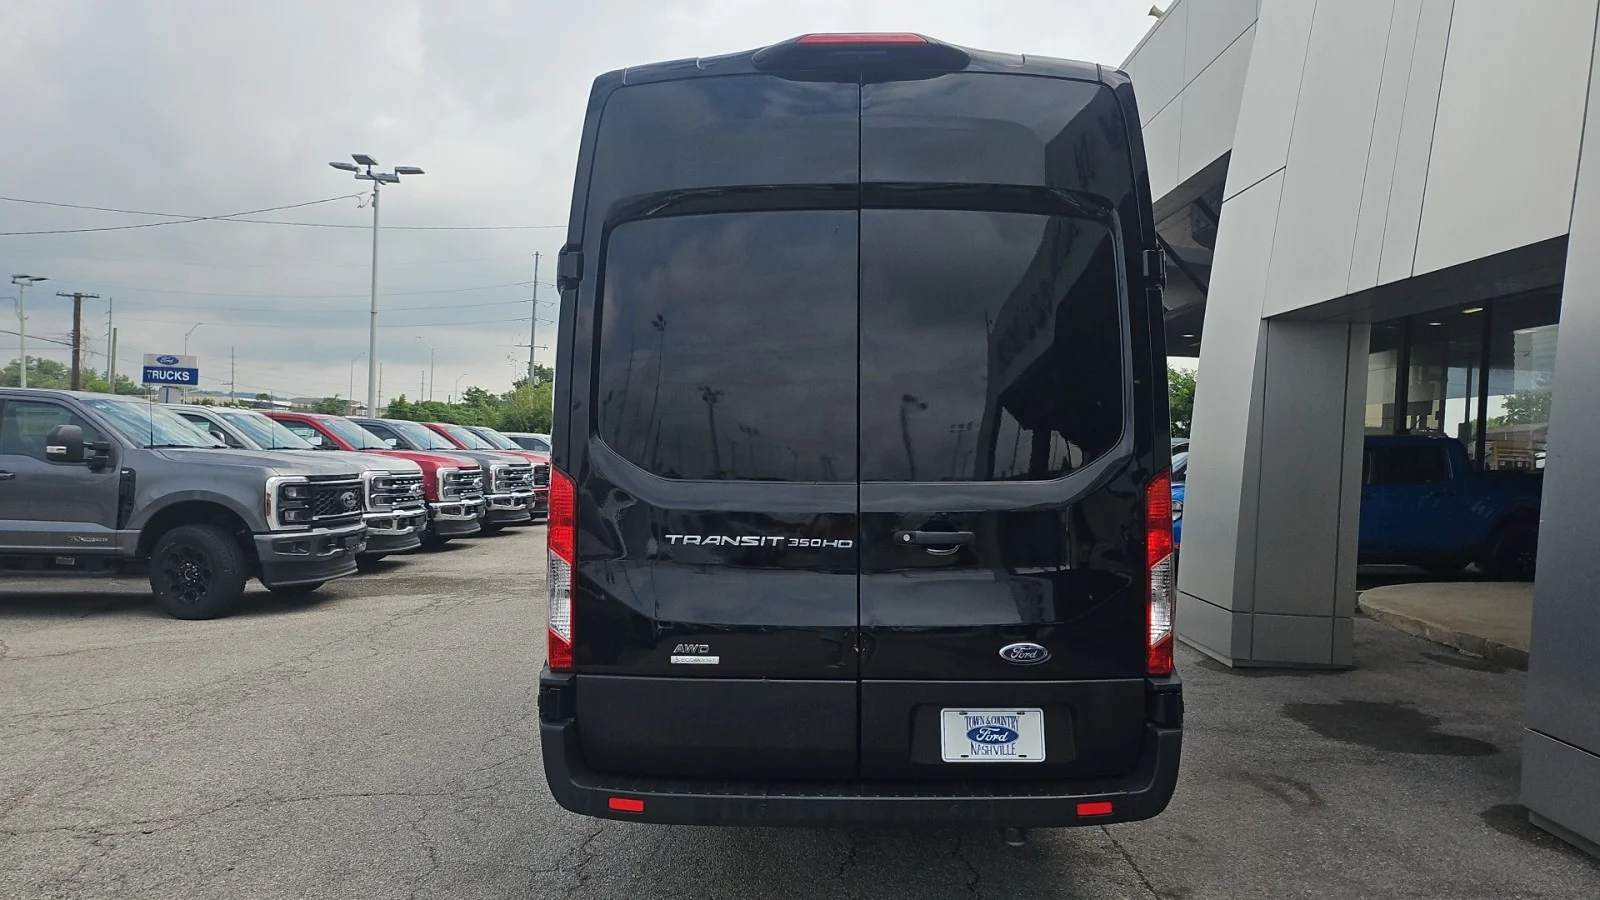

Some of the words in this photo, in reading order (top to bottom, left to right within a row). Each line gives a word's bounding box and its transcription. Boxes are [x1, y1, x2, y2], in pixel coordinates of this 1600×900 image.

[146, 369, 190, 381] TRUCKS
[665, 534, 784, 547] TRANSIT
[787, 538, 853, 549] 350HD
[673, 643, 710, 653] AWD
[1010, 647, 1038, 659] Ford
[964, 715, 985, 730] TOWN
[985, 715, 990, 725] &
[990, 715, 1020, 731] COUNTRY
[975, 727, 1009, 742] Ford
[970, 742, 1016, 755] NASHVILLE
